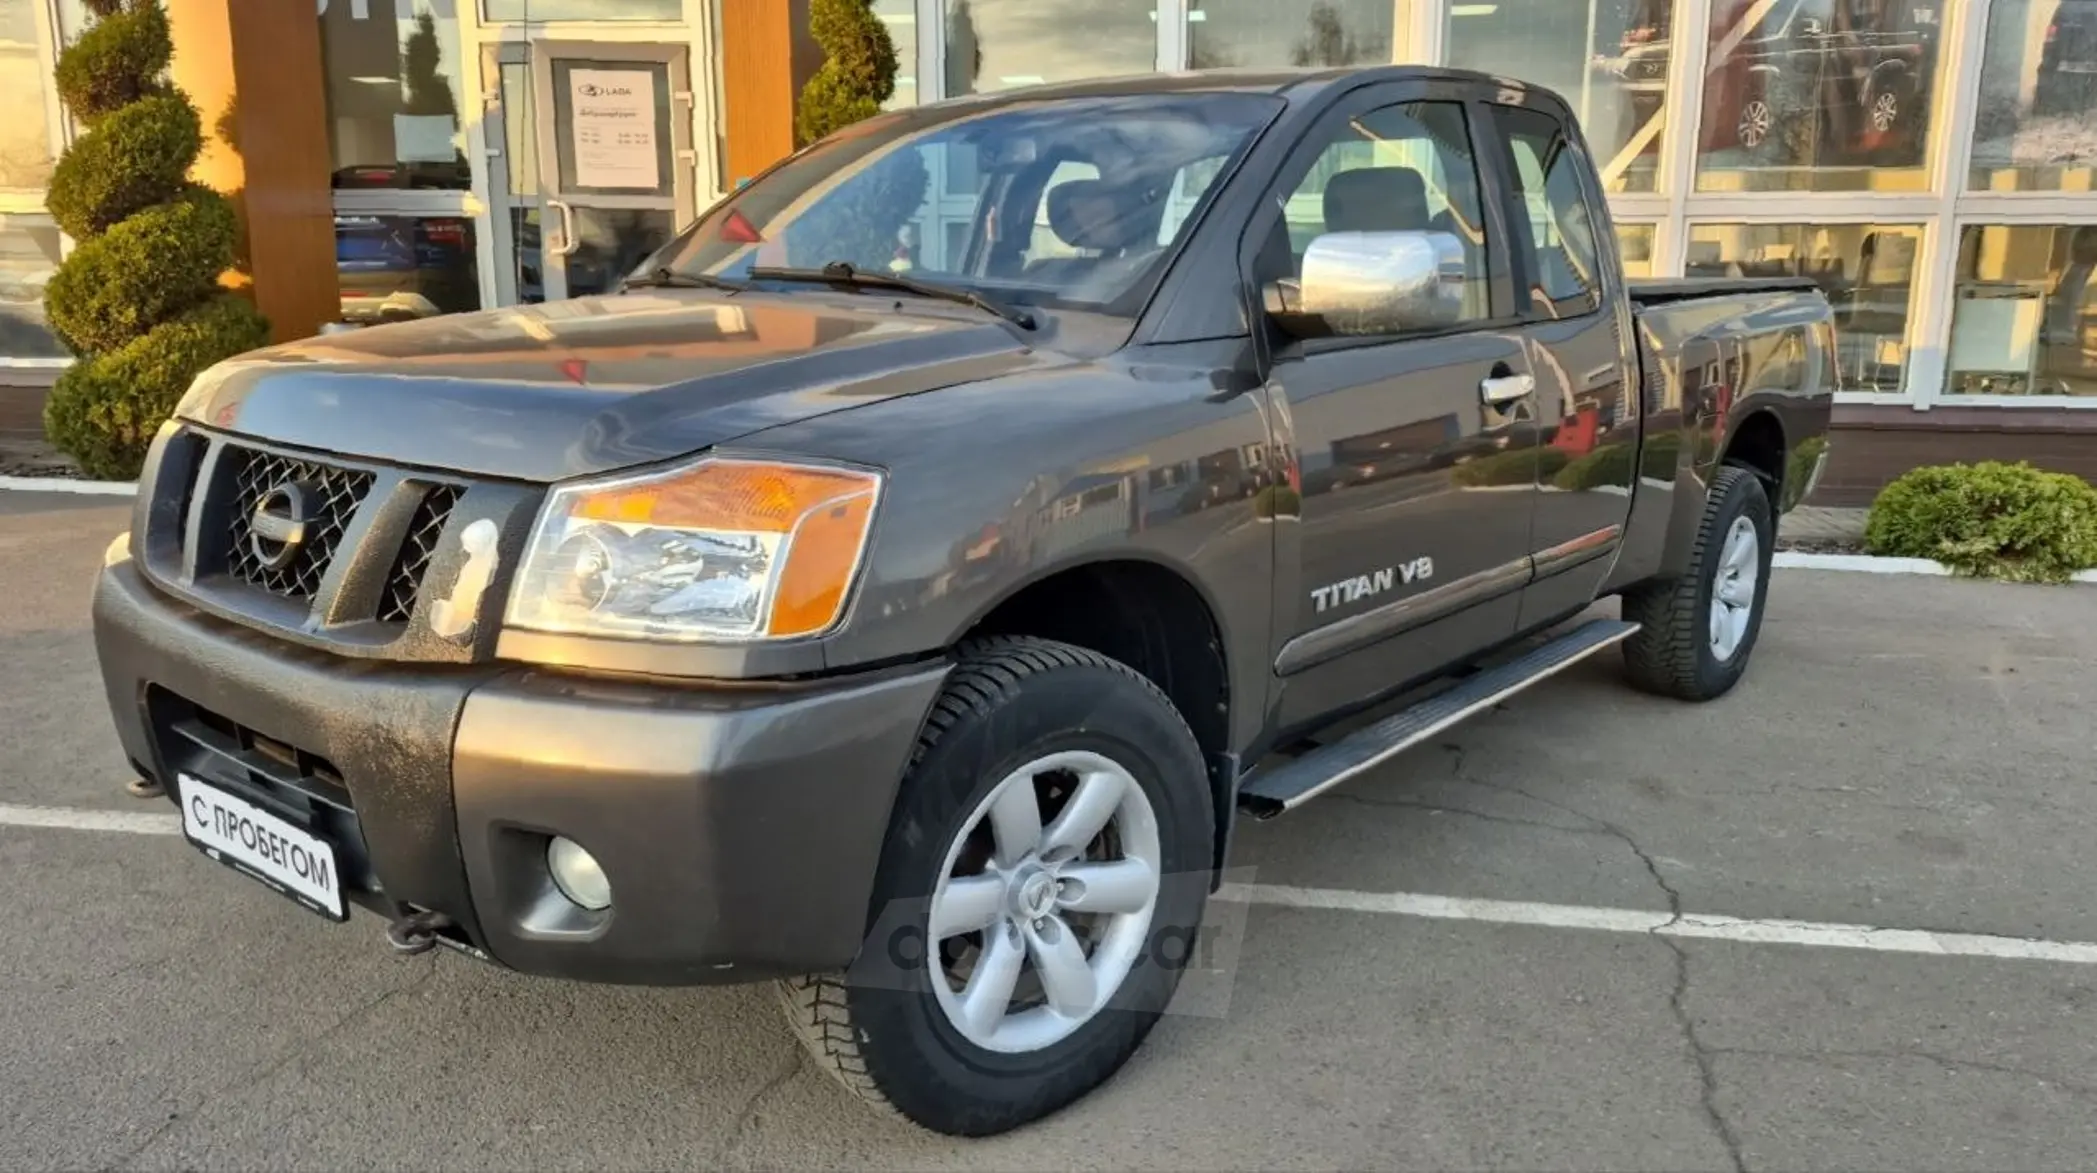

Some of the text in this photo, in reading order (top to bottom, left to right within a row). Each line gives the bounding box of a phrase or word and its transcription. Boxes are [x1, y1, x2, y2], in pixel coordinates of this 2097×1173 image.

[606, 87, 632, 97] LADA
[1310, 556, 1434, 614] TITAN V8
[191, 794, 331, 893] С ПРОБЕГОМ
